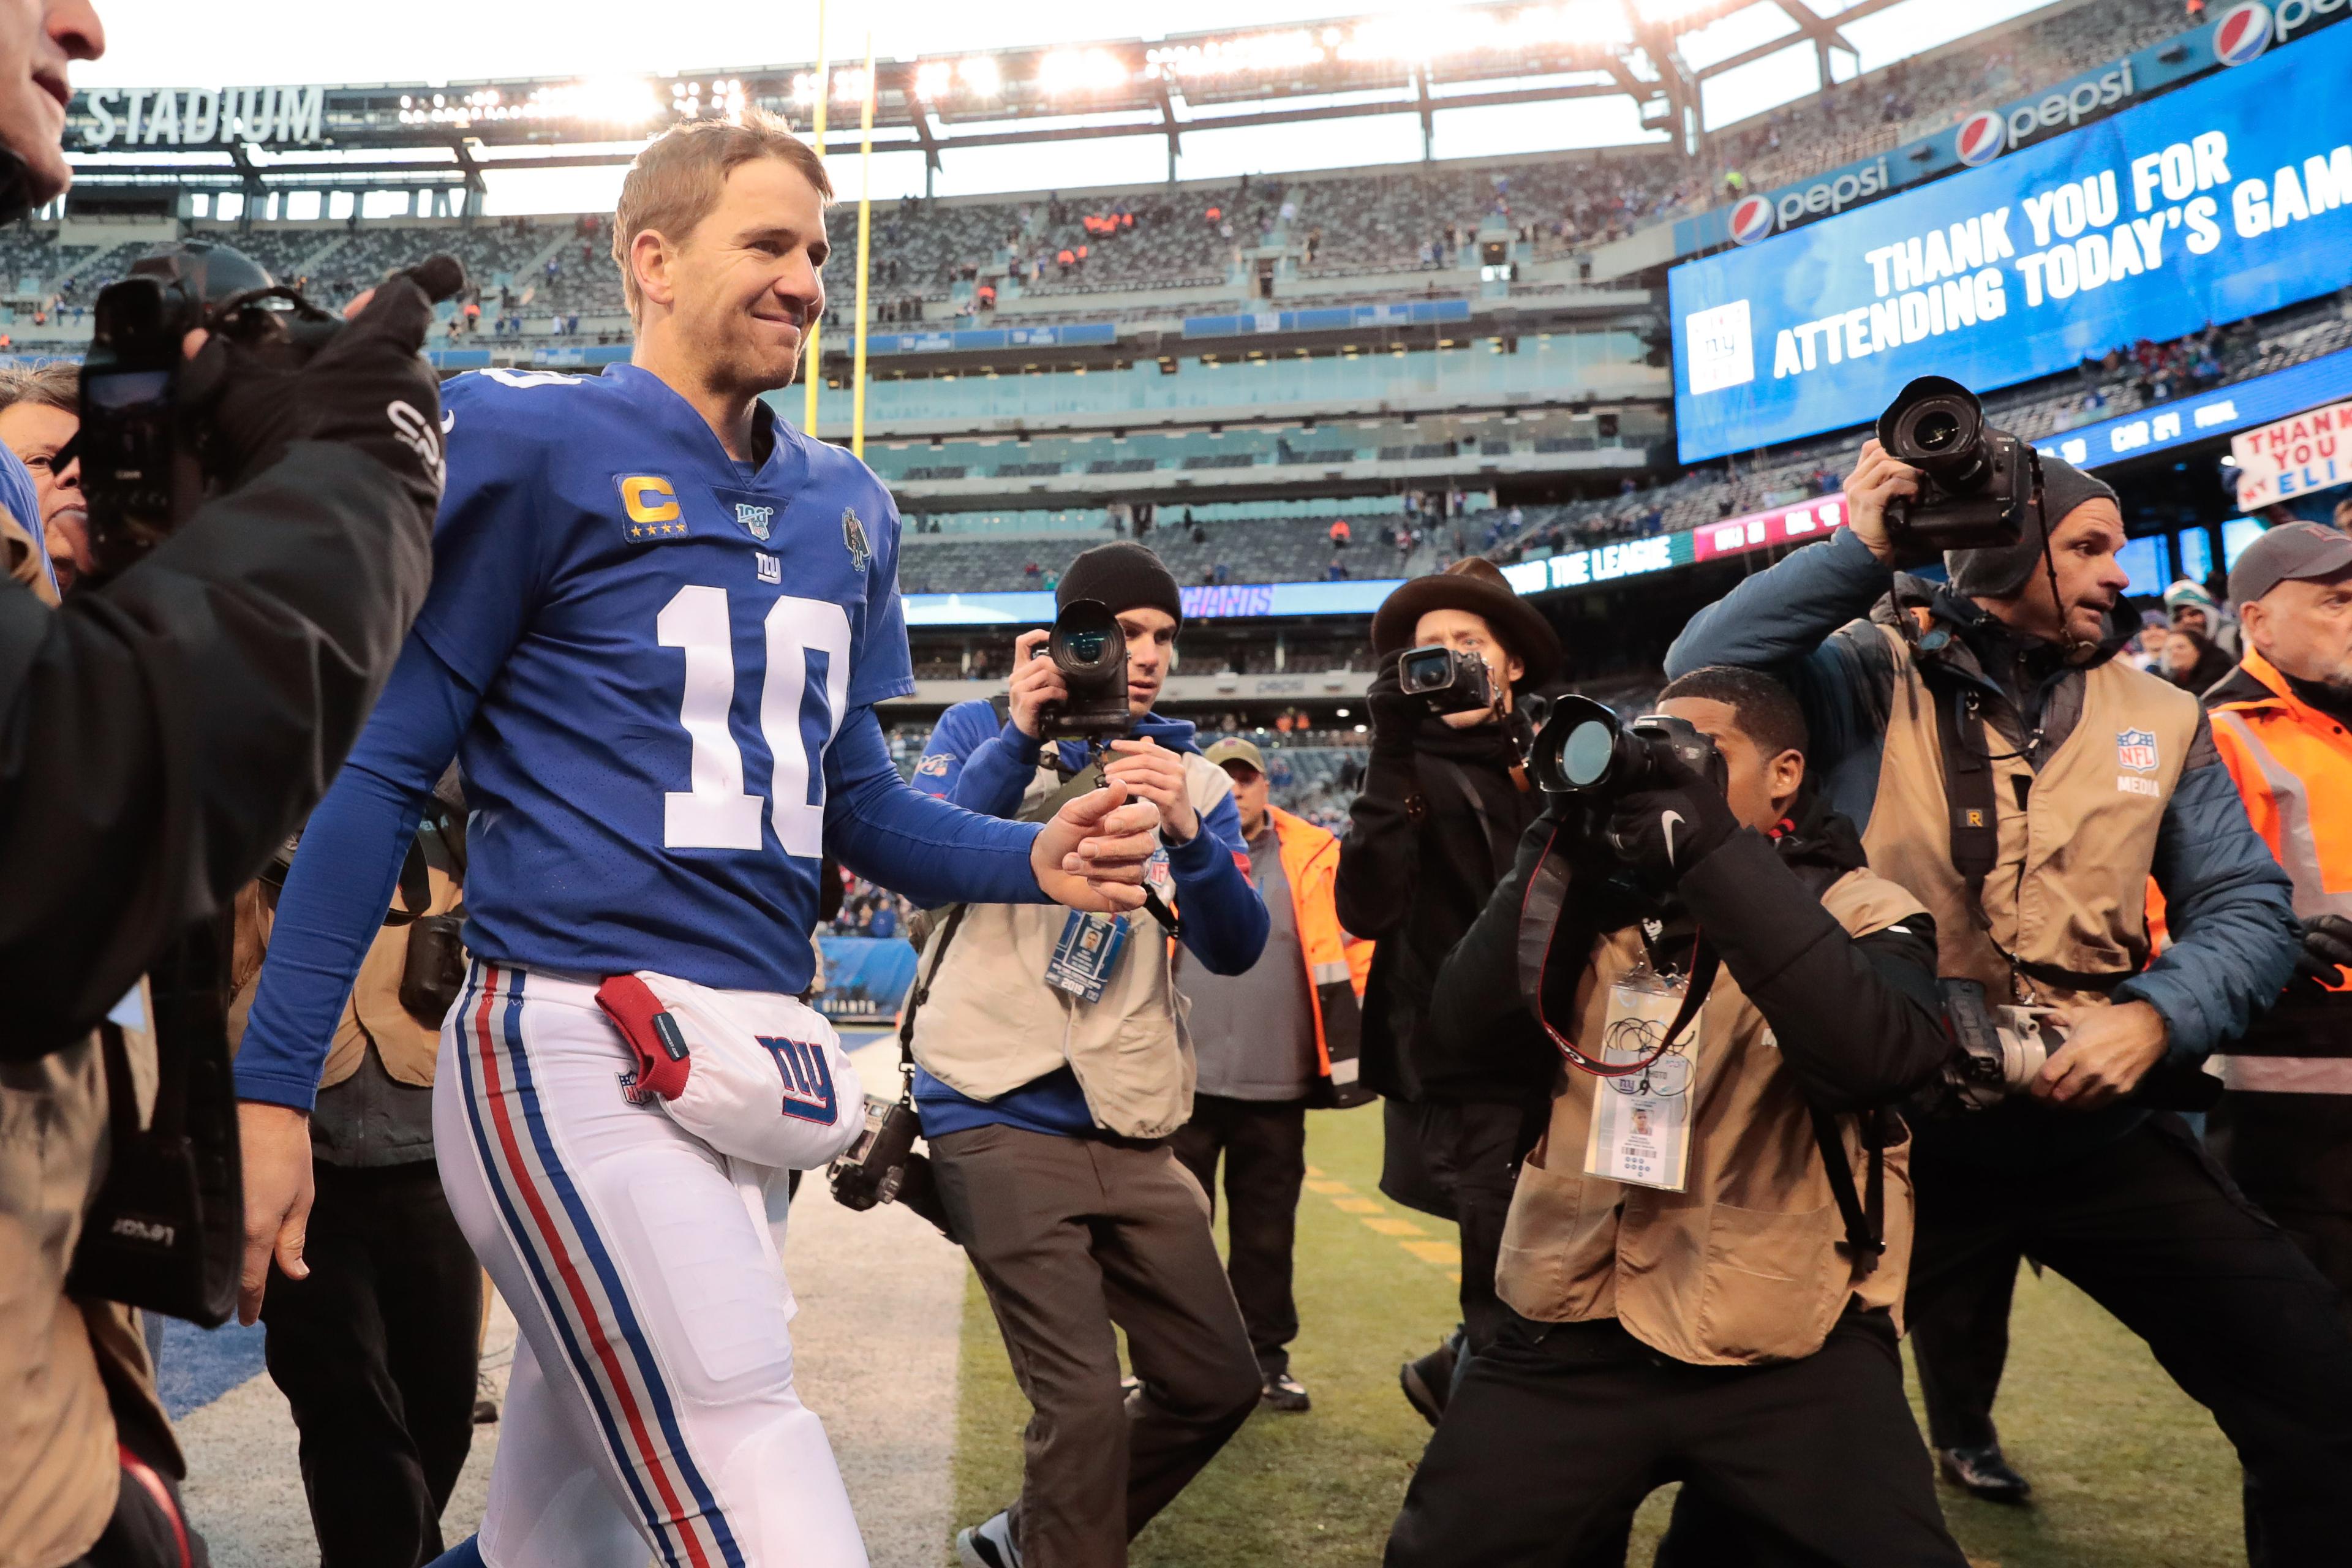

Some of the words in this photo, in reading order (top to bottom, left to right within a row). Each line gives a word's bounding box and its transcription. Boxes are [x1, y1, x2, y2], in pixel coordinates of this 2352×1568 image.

[83, 86, 324, 145] STADIUM
[2007, 60, 2134, 149] pepsi
[1778, 156, 1888, 231] pepsi
[1864, 206, 2015, 298] THANK
[2022, 168, 2119, 247] YOU
[2131, 130, 2232, 212] FOR
[1773, 267, 2007, 379] ATTENDING
[2016, 197, 2222, 308] TODAY'S
[2247, 408, 2352, 454] THANK
[2272, 436, 2336, 470] YOU
[621, 476, 680, 523] C
[2278, 460, 2336, 494] ELI
[1591, 535, 1673, 581] LEAGUE
[657, 585, 852, 859] 10
[2119, 746, 2154, 766] NFL
[2117, 775, 2160, 797] MEDIA
